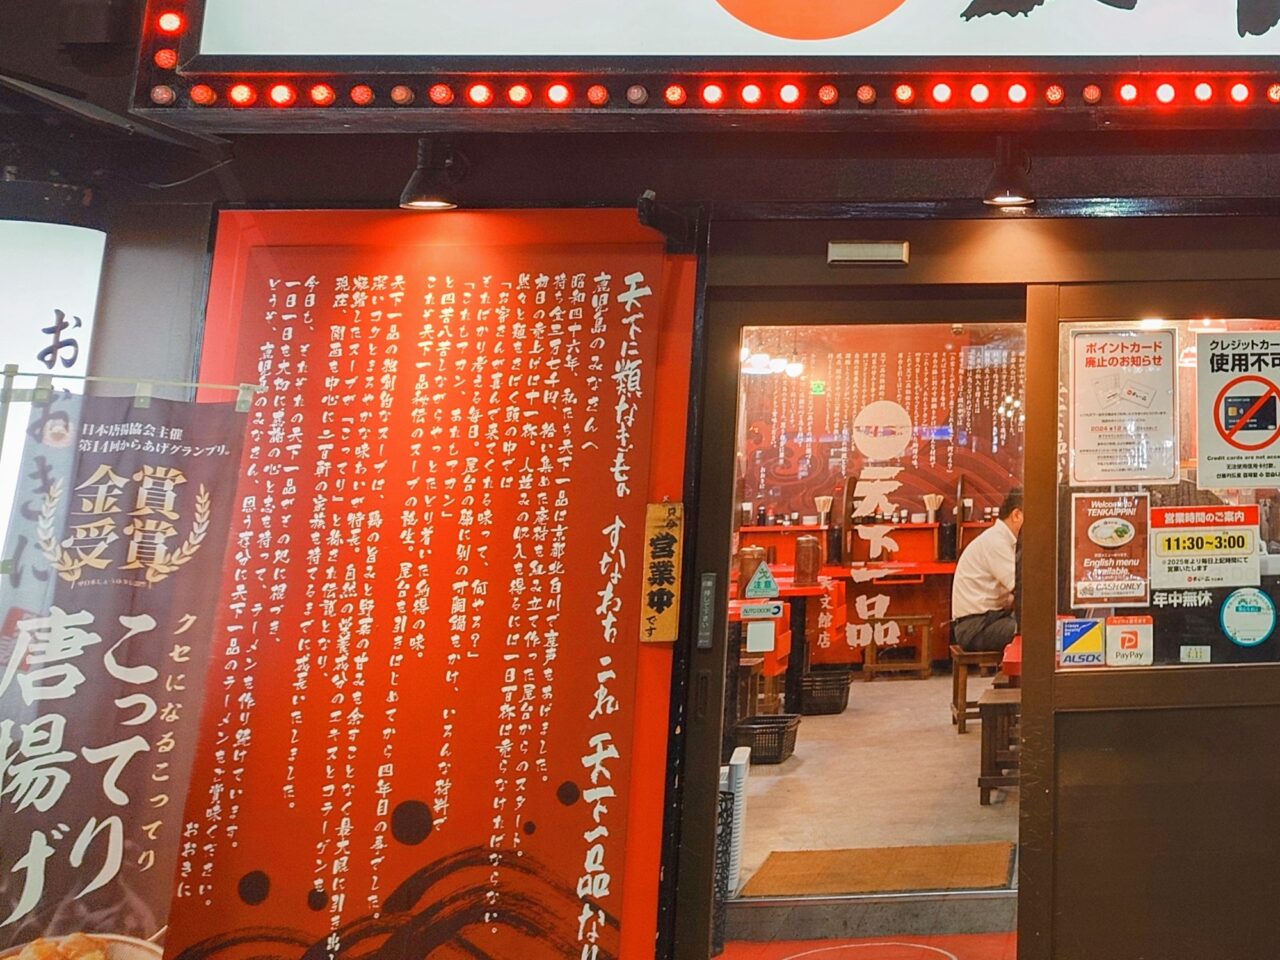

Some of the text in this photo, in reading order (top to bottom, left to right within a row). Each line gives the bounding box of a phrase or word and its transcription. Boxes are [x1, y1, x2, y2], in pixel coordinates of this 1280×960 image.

[581, 272, 611, 449] 鹿児島のみなさんへ
[1085, 355, 1163, 368] 廃止のお知らせ
[1086, 342, 1163, 353] ポイントカード
[71, 464, 189, 519] 金賞
[1164, 512, 1245, 524] 営業時間のご案内
[62, 518, 180, 572] 受賞
[846, 466, 904, 647] 天下一品
[1083, 558, 1139, 568] English menu
[647, 532, 678, 614] 営業中
[1120, 582, 1142, 590] ONLY
[1152, 591, 1213, 609] 年中無休
[645, 615, 657, 637] です
[1062, 654, 1102, 664] ALSOK
[1115, 651, 1144, 660] PayPay
[70, 614, 158, 900] こってり
[138, 613, 197, 873] クセになるこってり
[0, 606, 103, 928] 唐揚げ
[177, 822, 198, 897] おおきに
